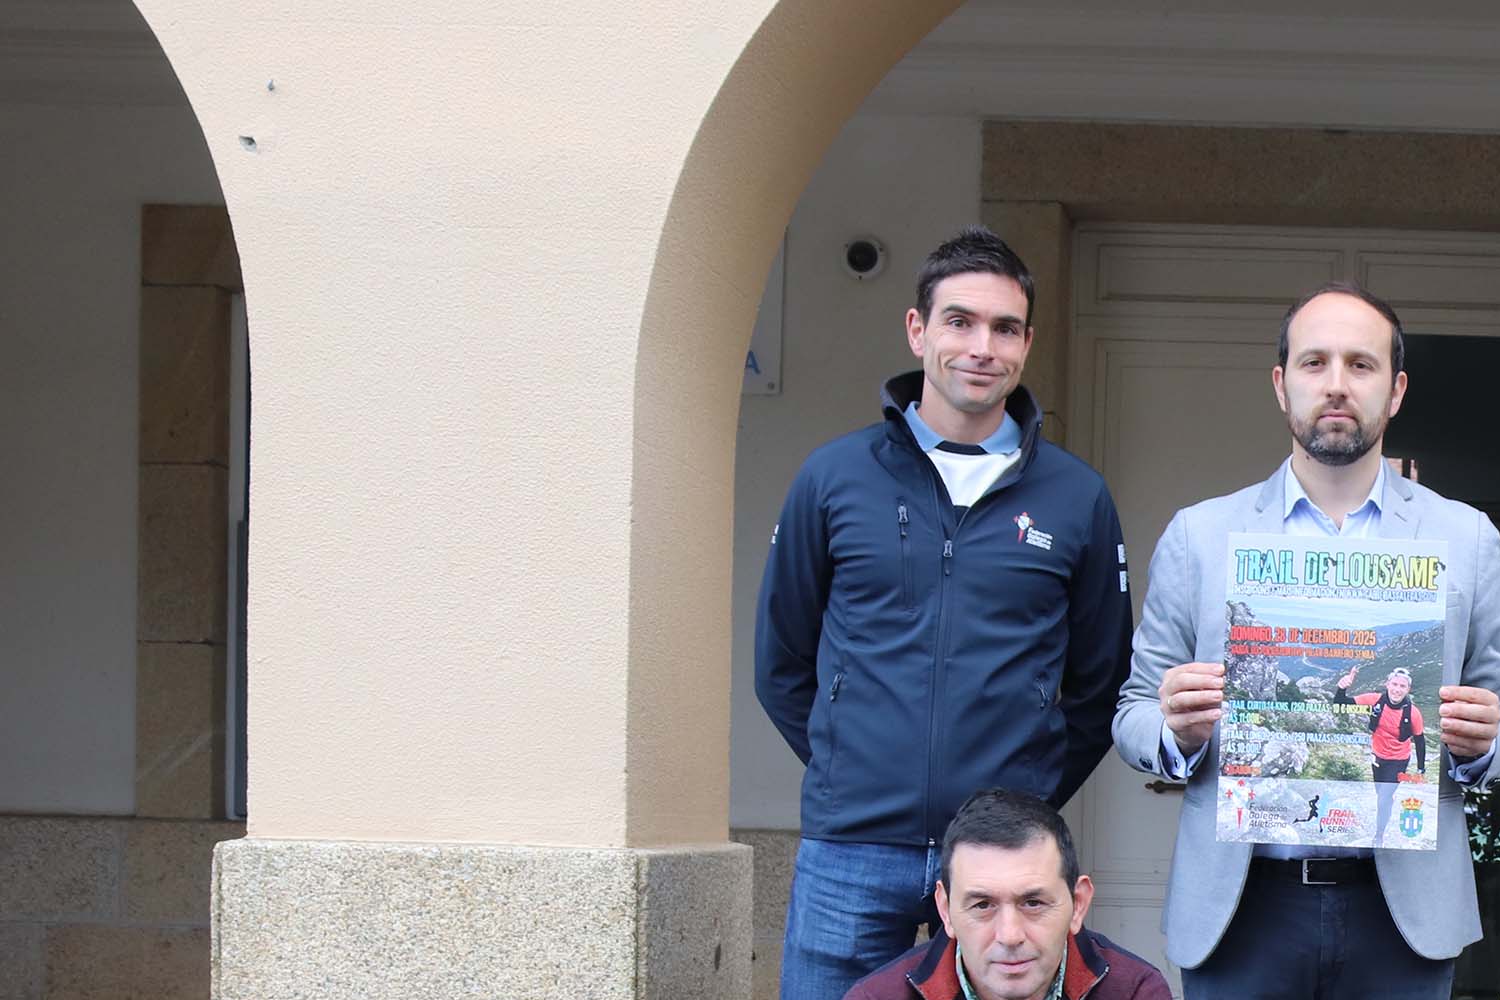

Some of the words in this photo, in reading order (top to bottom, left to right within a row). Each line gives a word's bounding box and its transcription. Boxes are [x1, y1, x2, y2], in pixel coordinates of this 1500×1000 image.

[1233, 547, 1299, 586] TRAIL
[1303, 550, 1331, 586] DE
[1335, 551, 1439, 591] LOUSAME
[1288, 627, 1299, 643] DE
[1301, 627, 1350, 646] DECEMBRO
[1352, 629, 1377, 646] 2025
[1228, 699, 1245, 709] TRAIL
[1248, 810, 1279, 821] Galega
